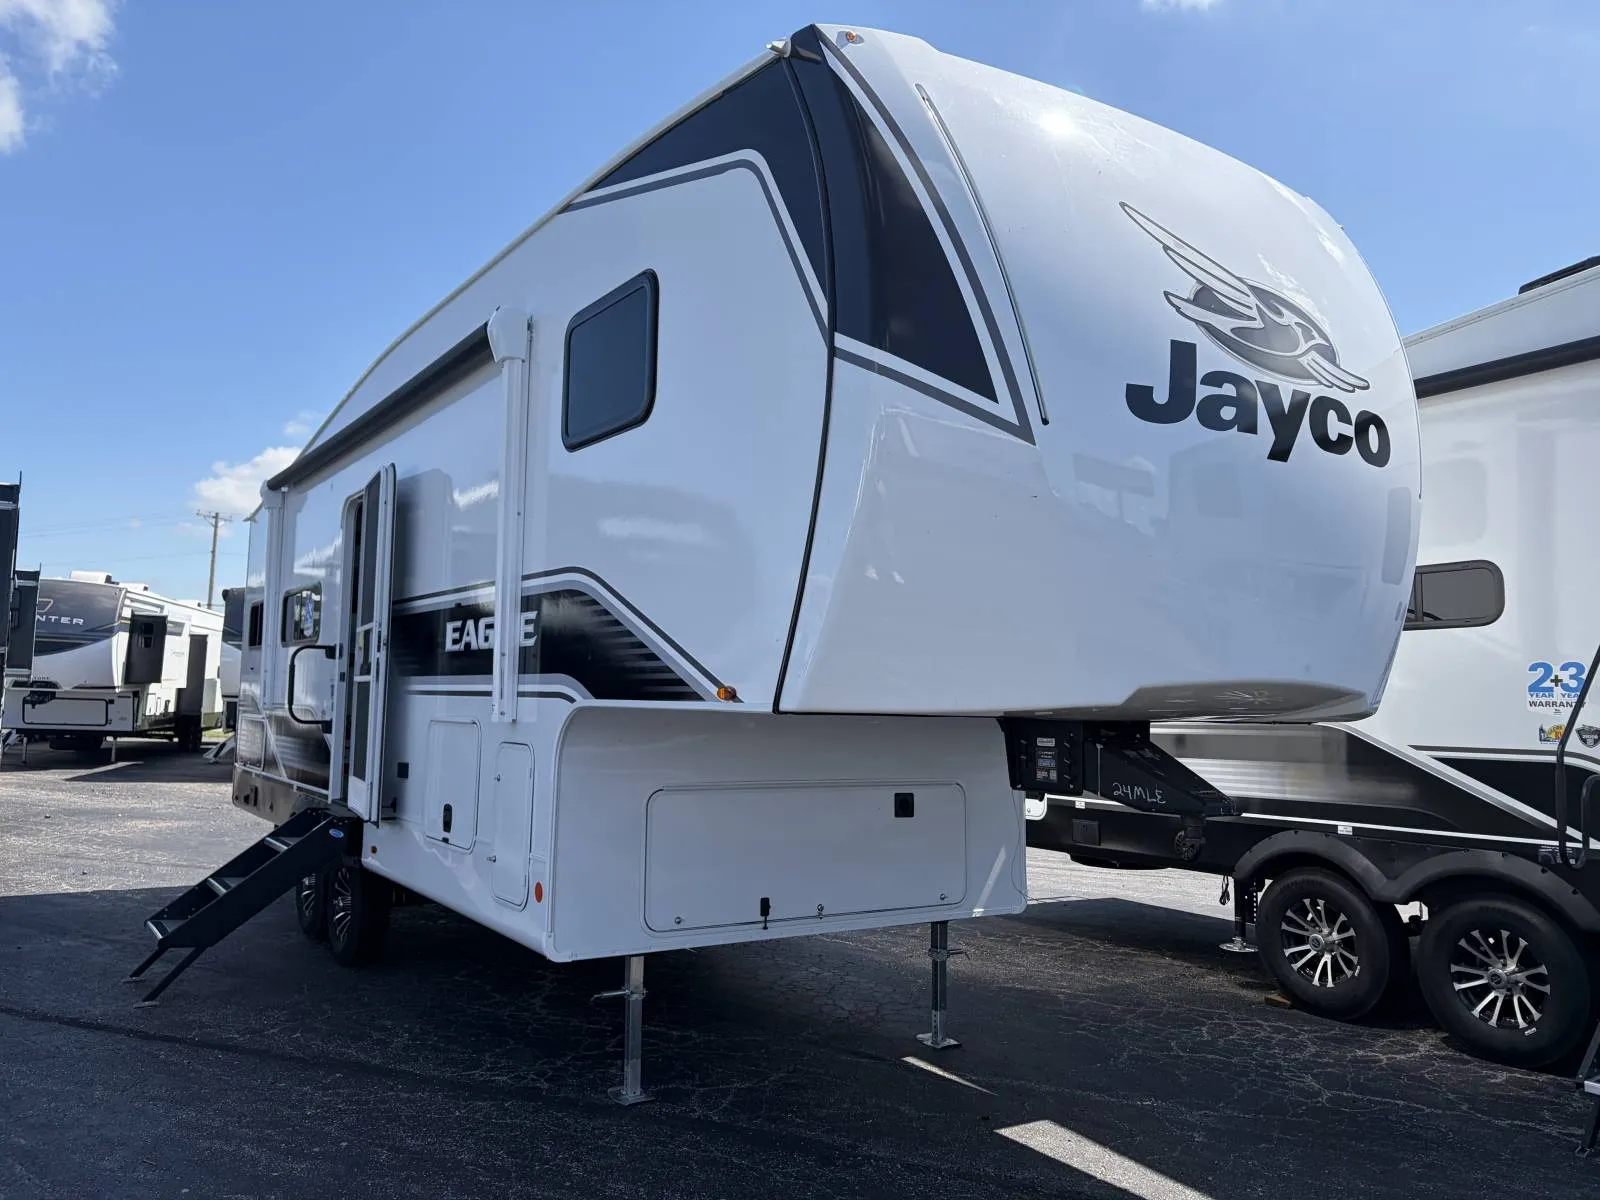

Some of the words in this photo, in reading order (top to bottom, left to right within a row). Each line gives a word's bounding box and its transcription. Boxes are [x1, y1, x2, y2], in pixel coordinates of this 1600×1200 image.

[1125, 339, 1391, 468] Jayco
[35, 615, 84, 626] NTER
[445, 611, 538, 652] EAGE
